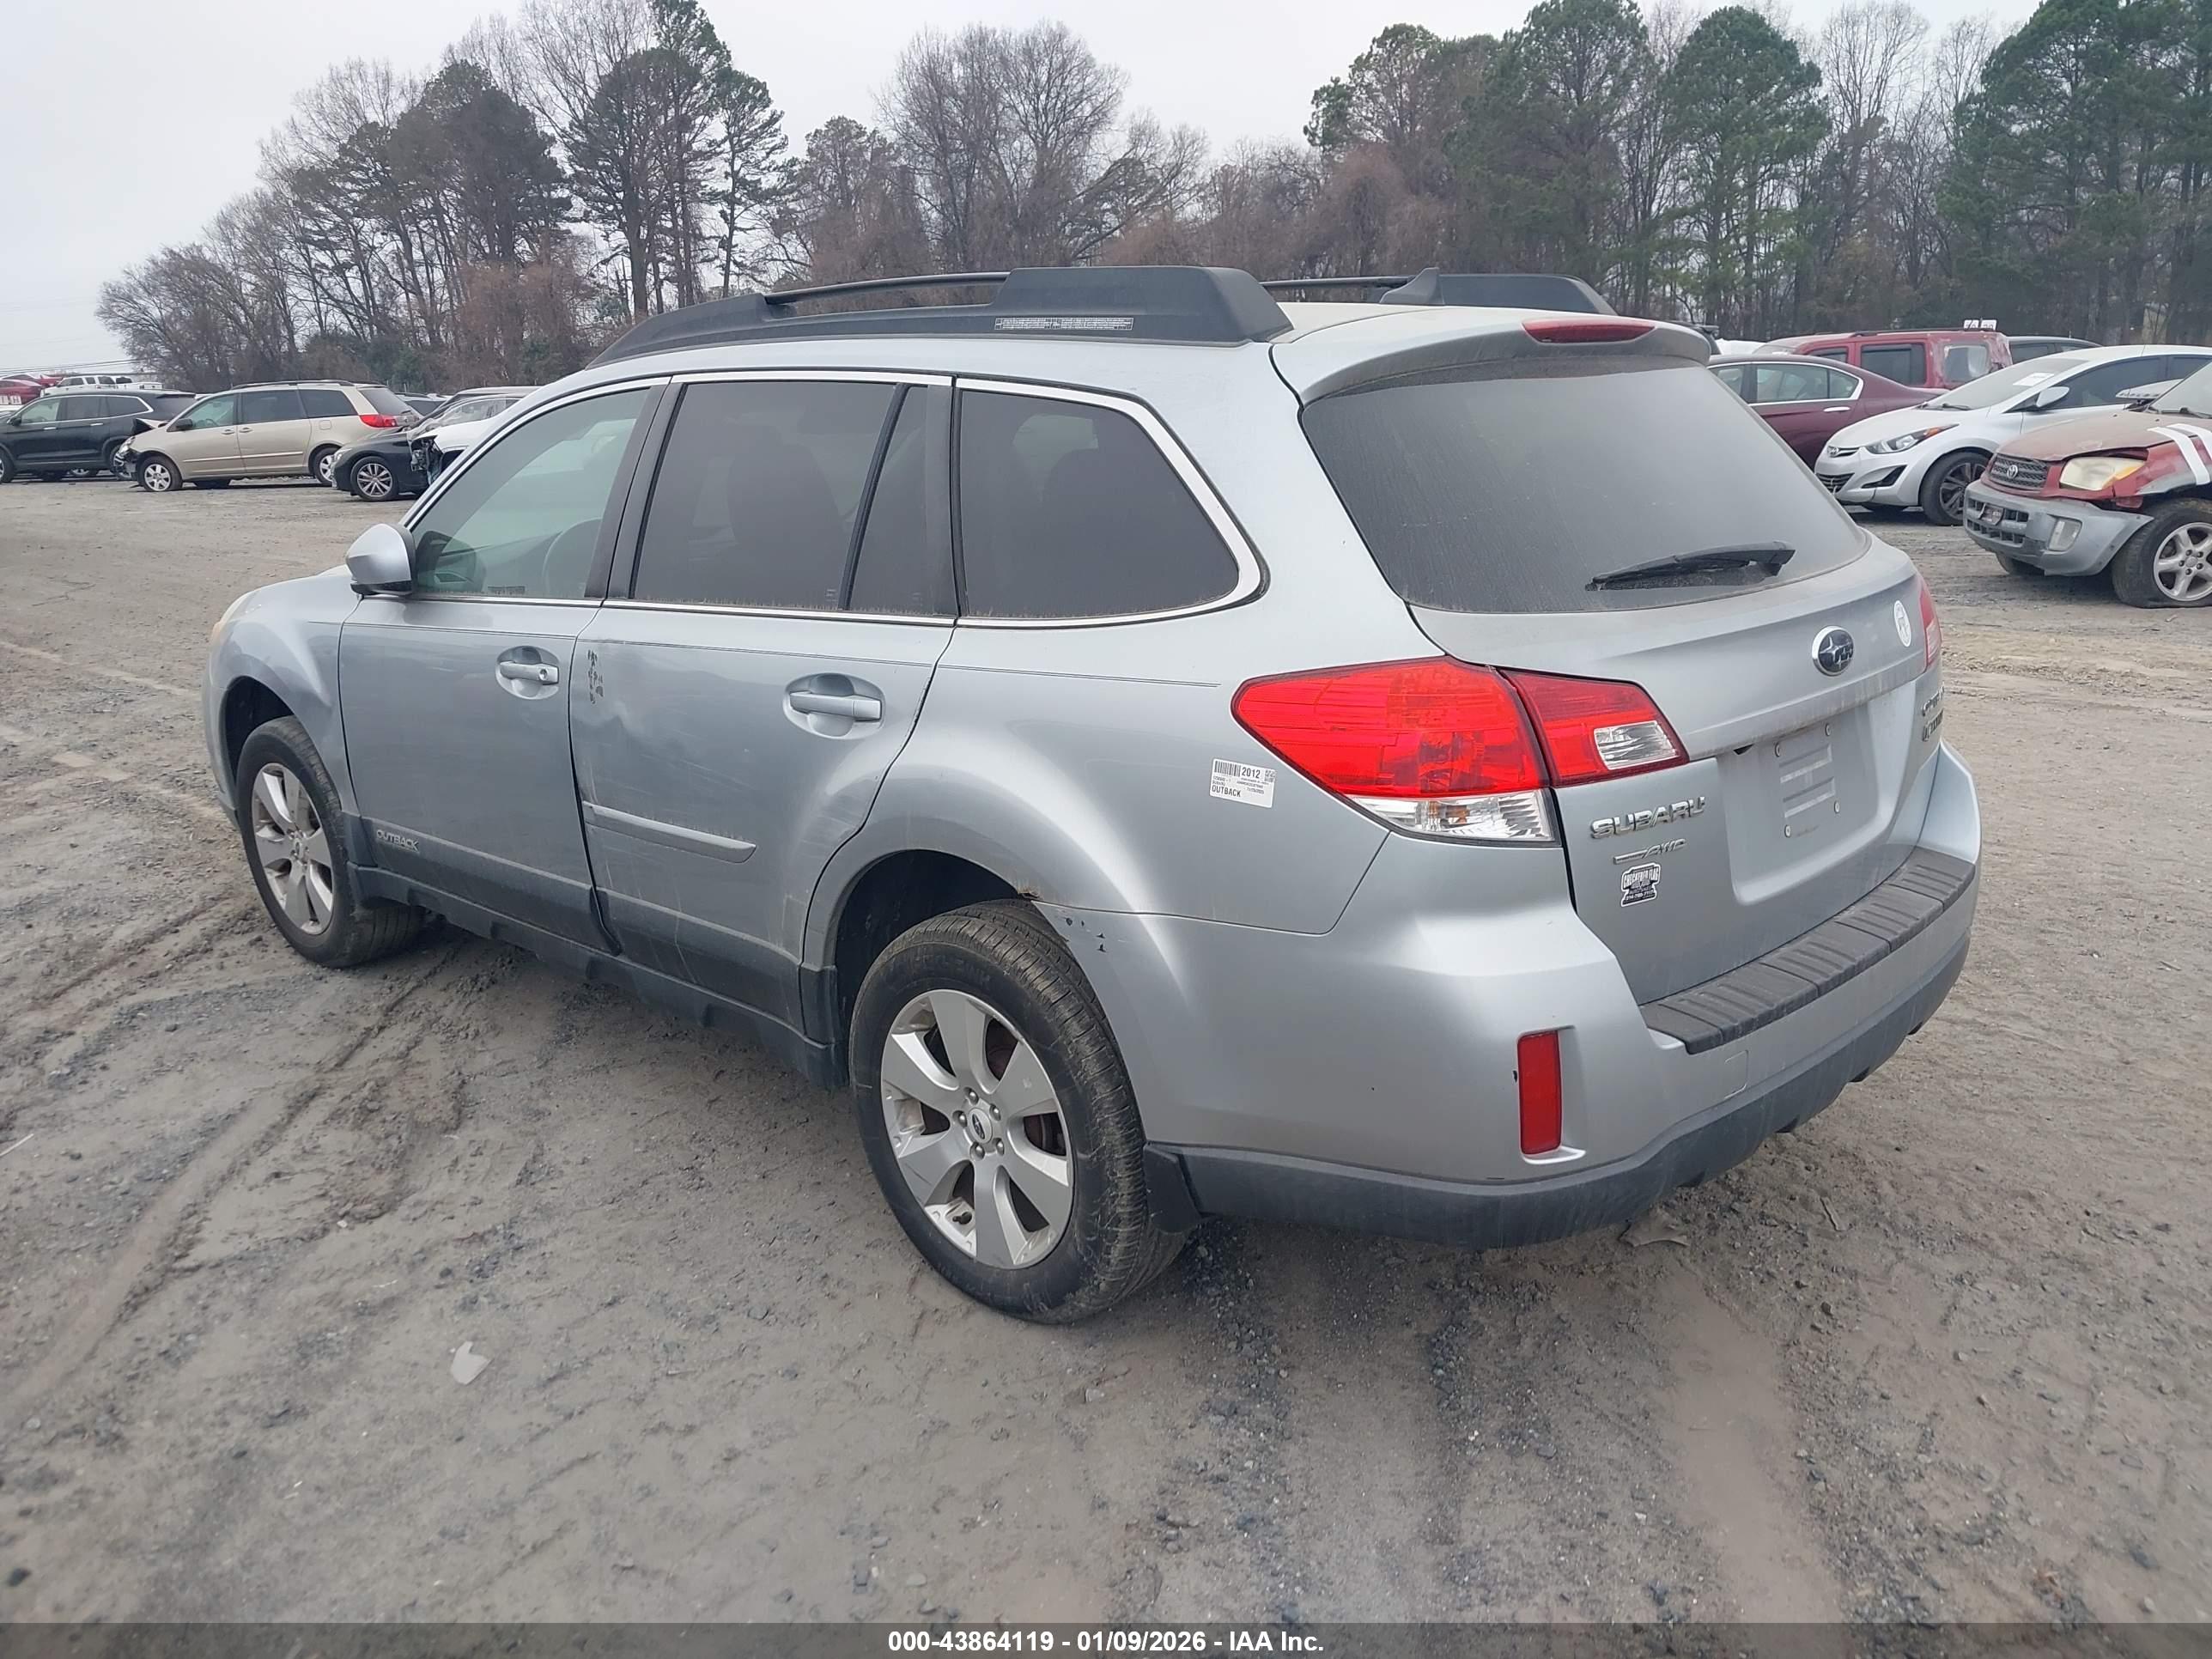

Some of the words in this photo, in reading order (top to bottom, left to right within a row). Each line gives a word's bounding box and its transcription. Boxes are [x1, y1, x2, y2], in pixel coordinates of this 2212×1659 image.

[1242, 766, 1261, 779] 2012
[1212, 785, 1242, 798] OUTBACK
[1590, 796, 1705, 839] SUBARU
[376, 829, 420, 852] OUTBACK
